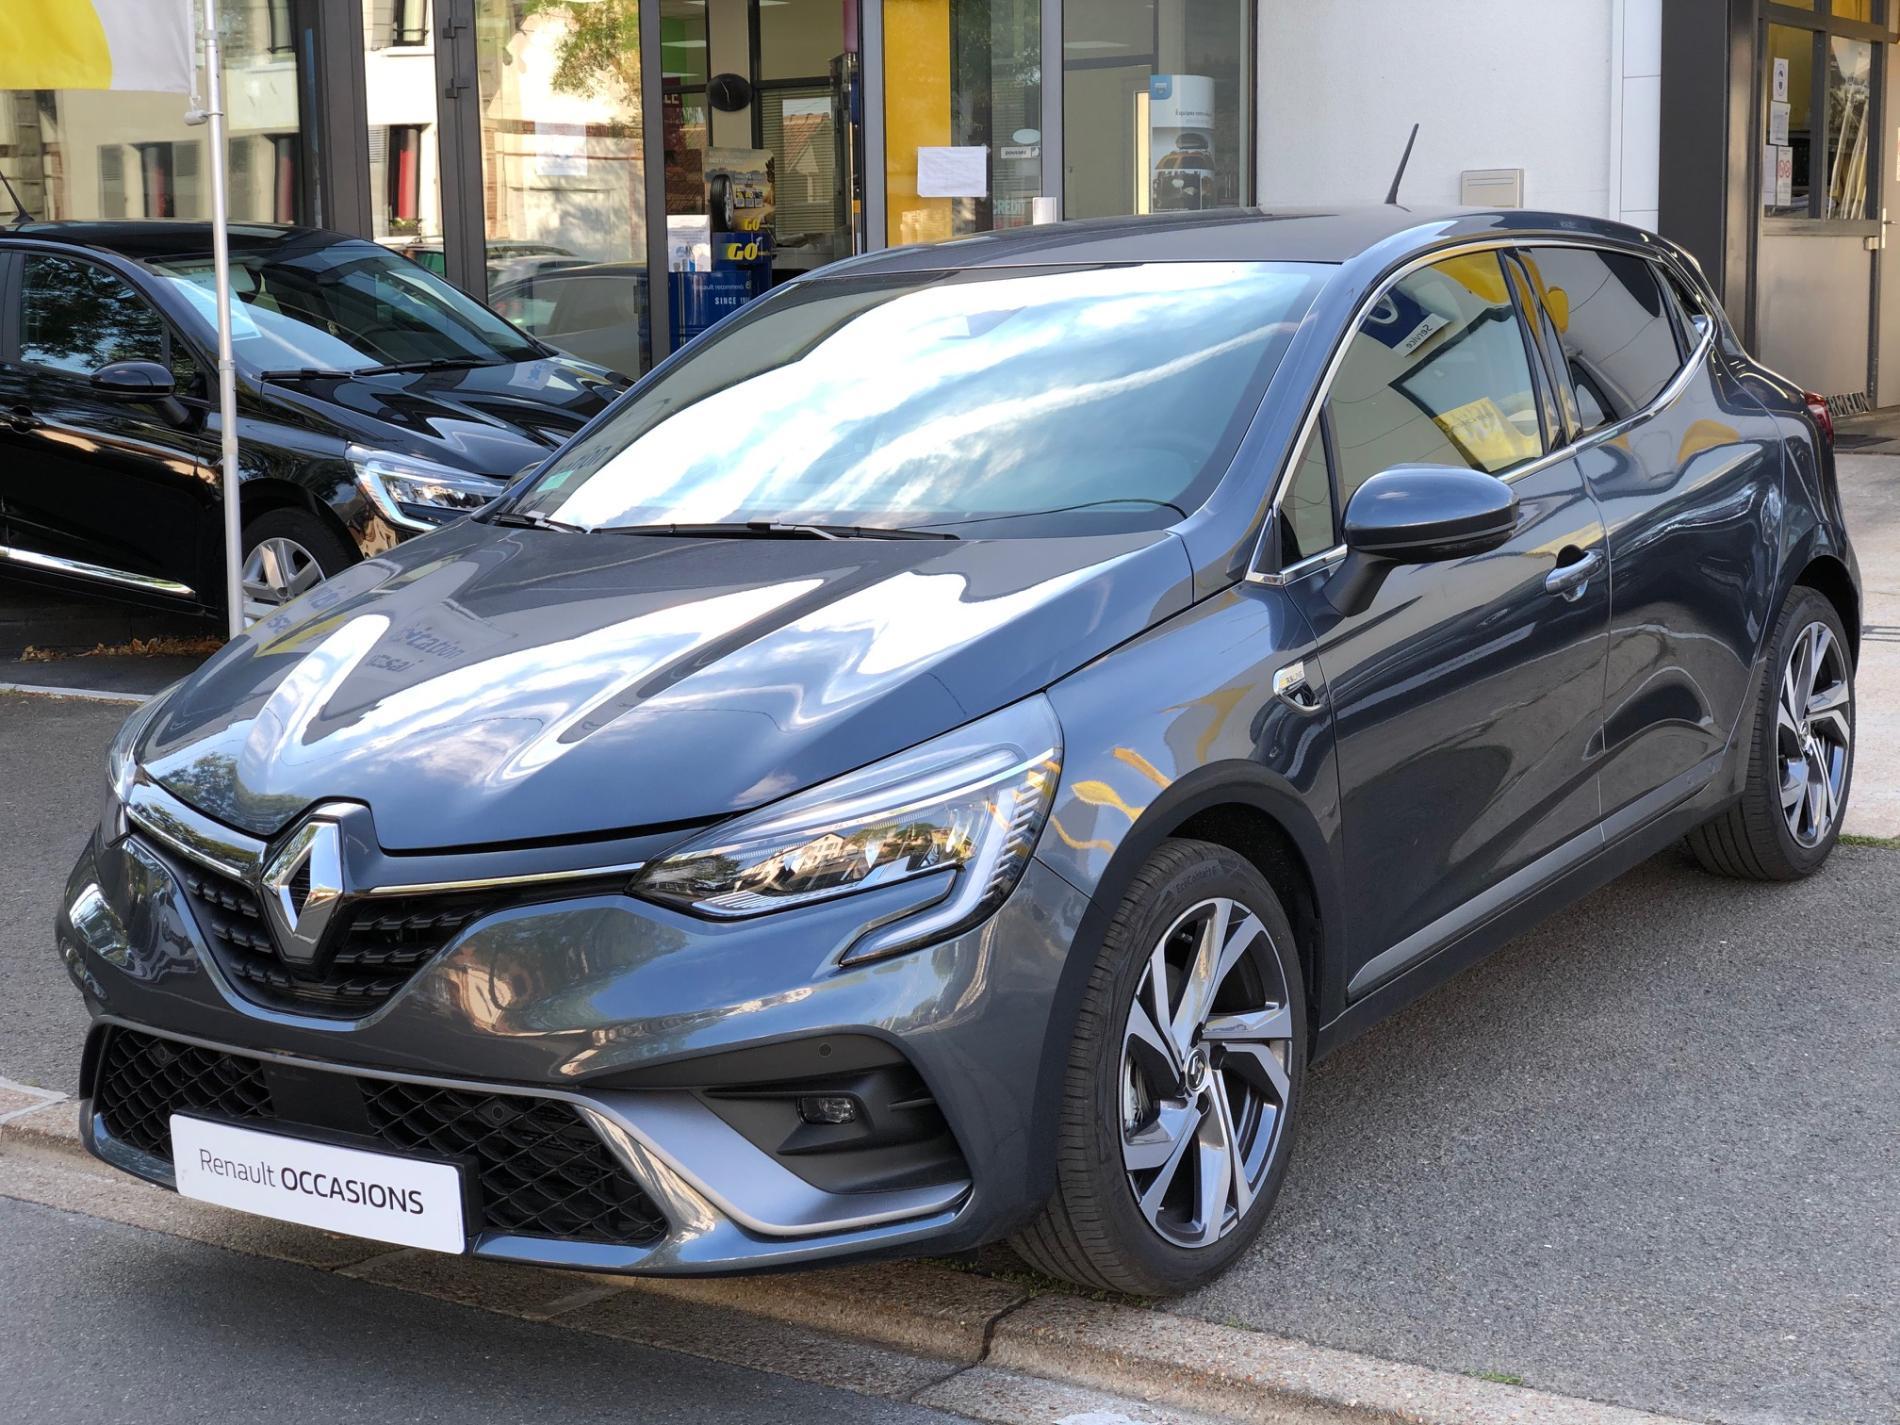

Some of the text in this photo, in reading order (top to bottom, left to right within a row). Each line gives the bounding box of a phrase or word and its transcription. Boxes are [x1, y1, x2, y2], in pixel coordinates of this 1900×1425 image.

[728, 243, 758, 260] GO
[714, 297, 737, 305] SINCE
[199, 1148, 425, 1216] Renault OCCASIONS
